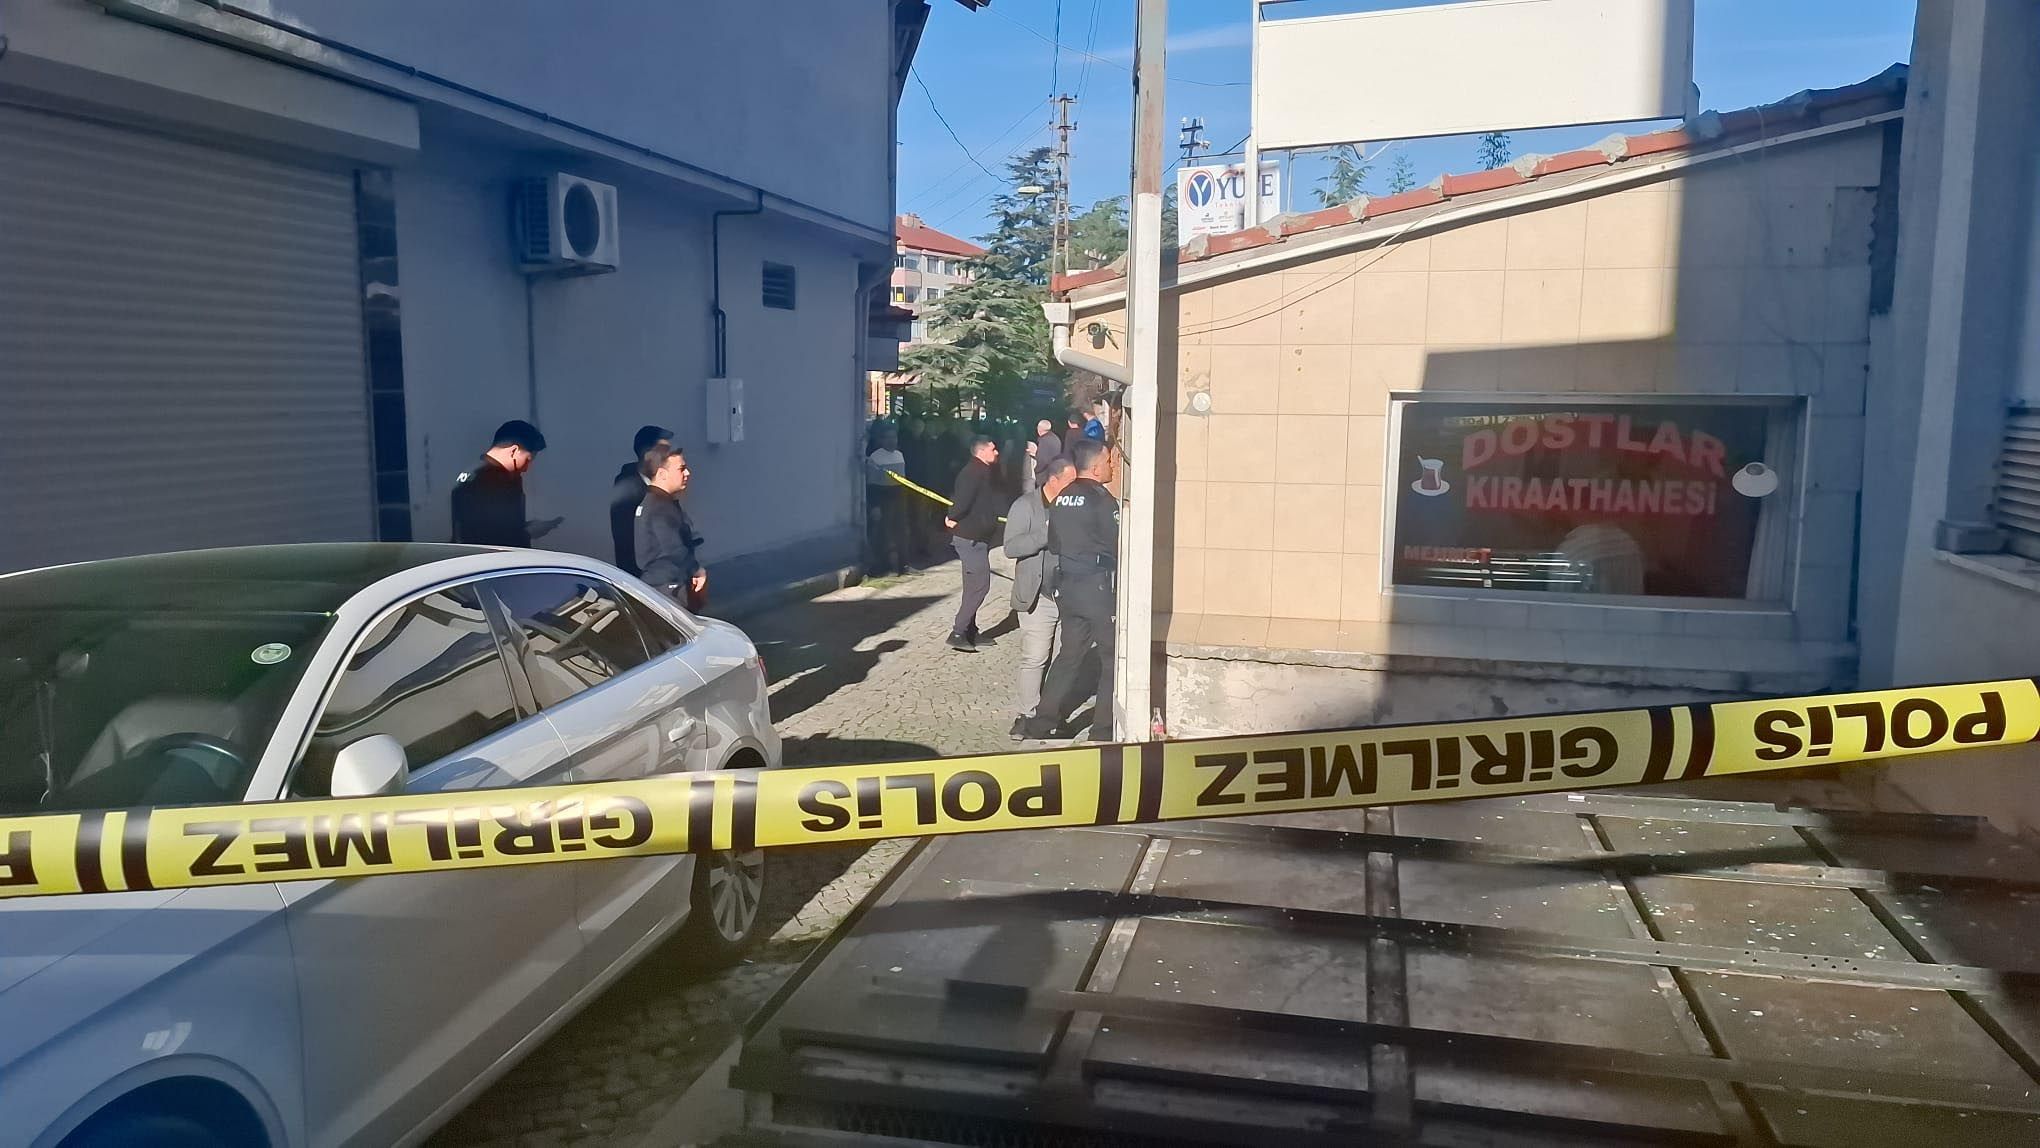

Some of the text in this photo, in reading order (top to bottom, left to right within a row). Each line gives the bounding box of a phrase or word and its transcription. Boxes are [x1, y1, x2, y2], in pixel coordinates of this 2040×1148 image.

[1216, 173, 1274, 200] YUE
[1462, 412, 1728, 477] DOSTLAR
[1753, 690, 2008, 762] POLİS
[798, 763, 1064, 833] POLİS
[1194, 723, 1619, 807] GİRİLMEZ
